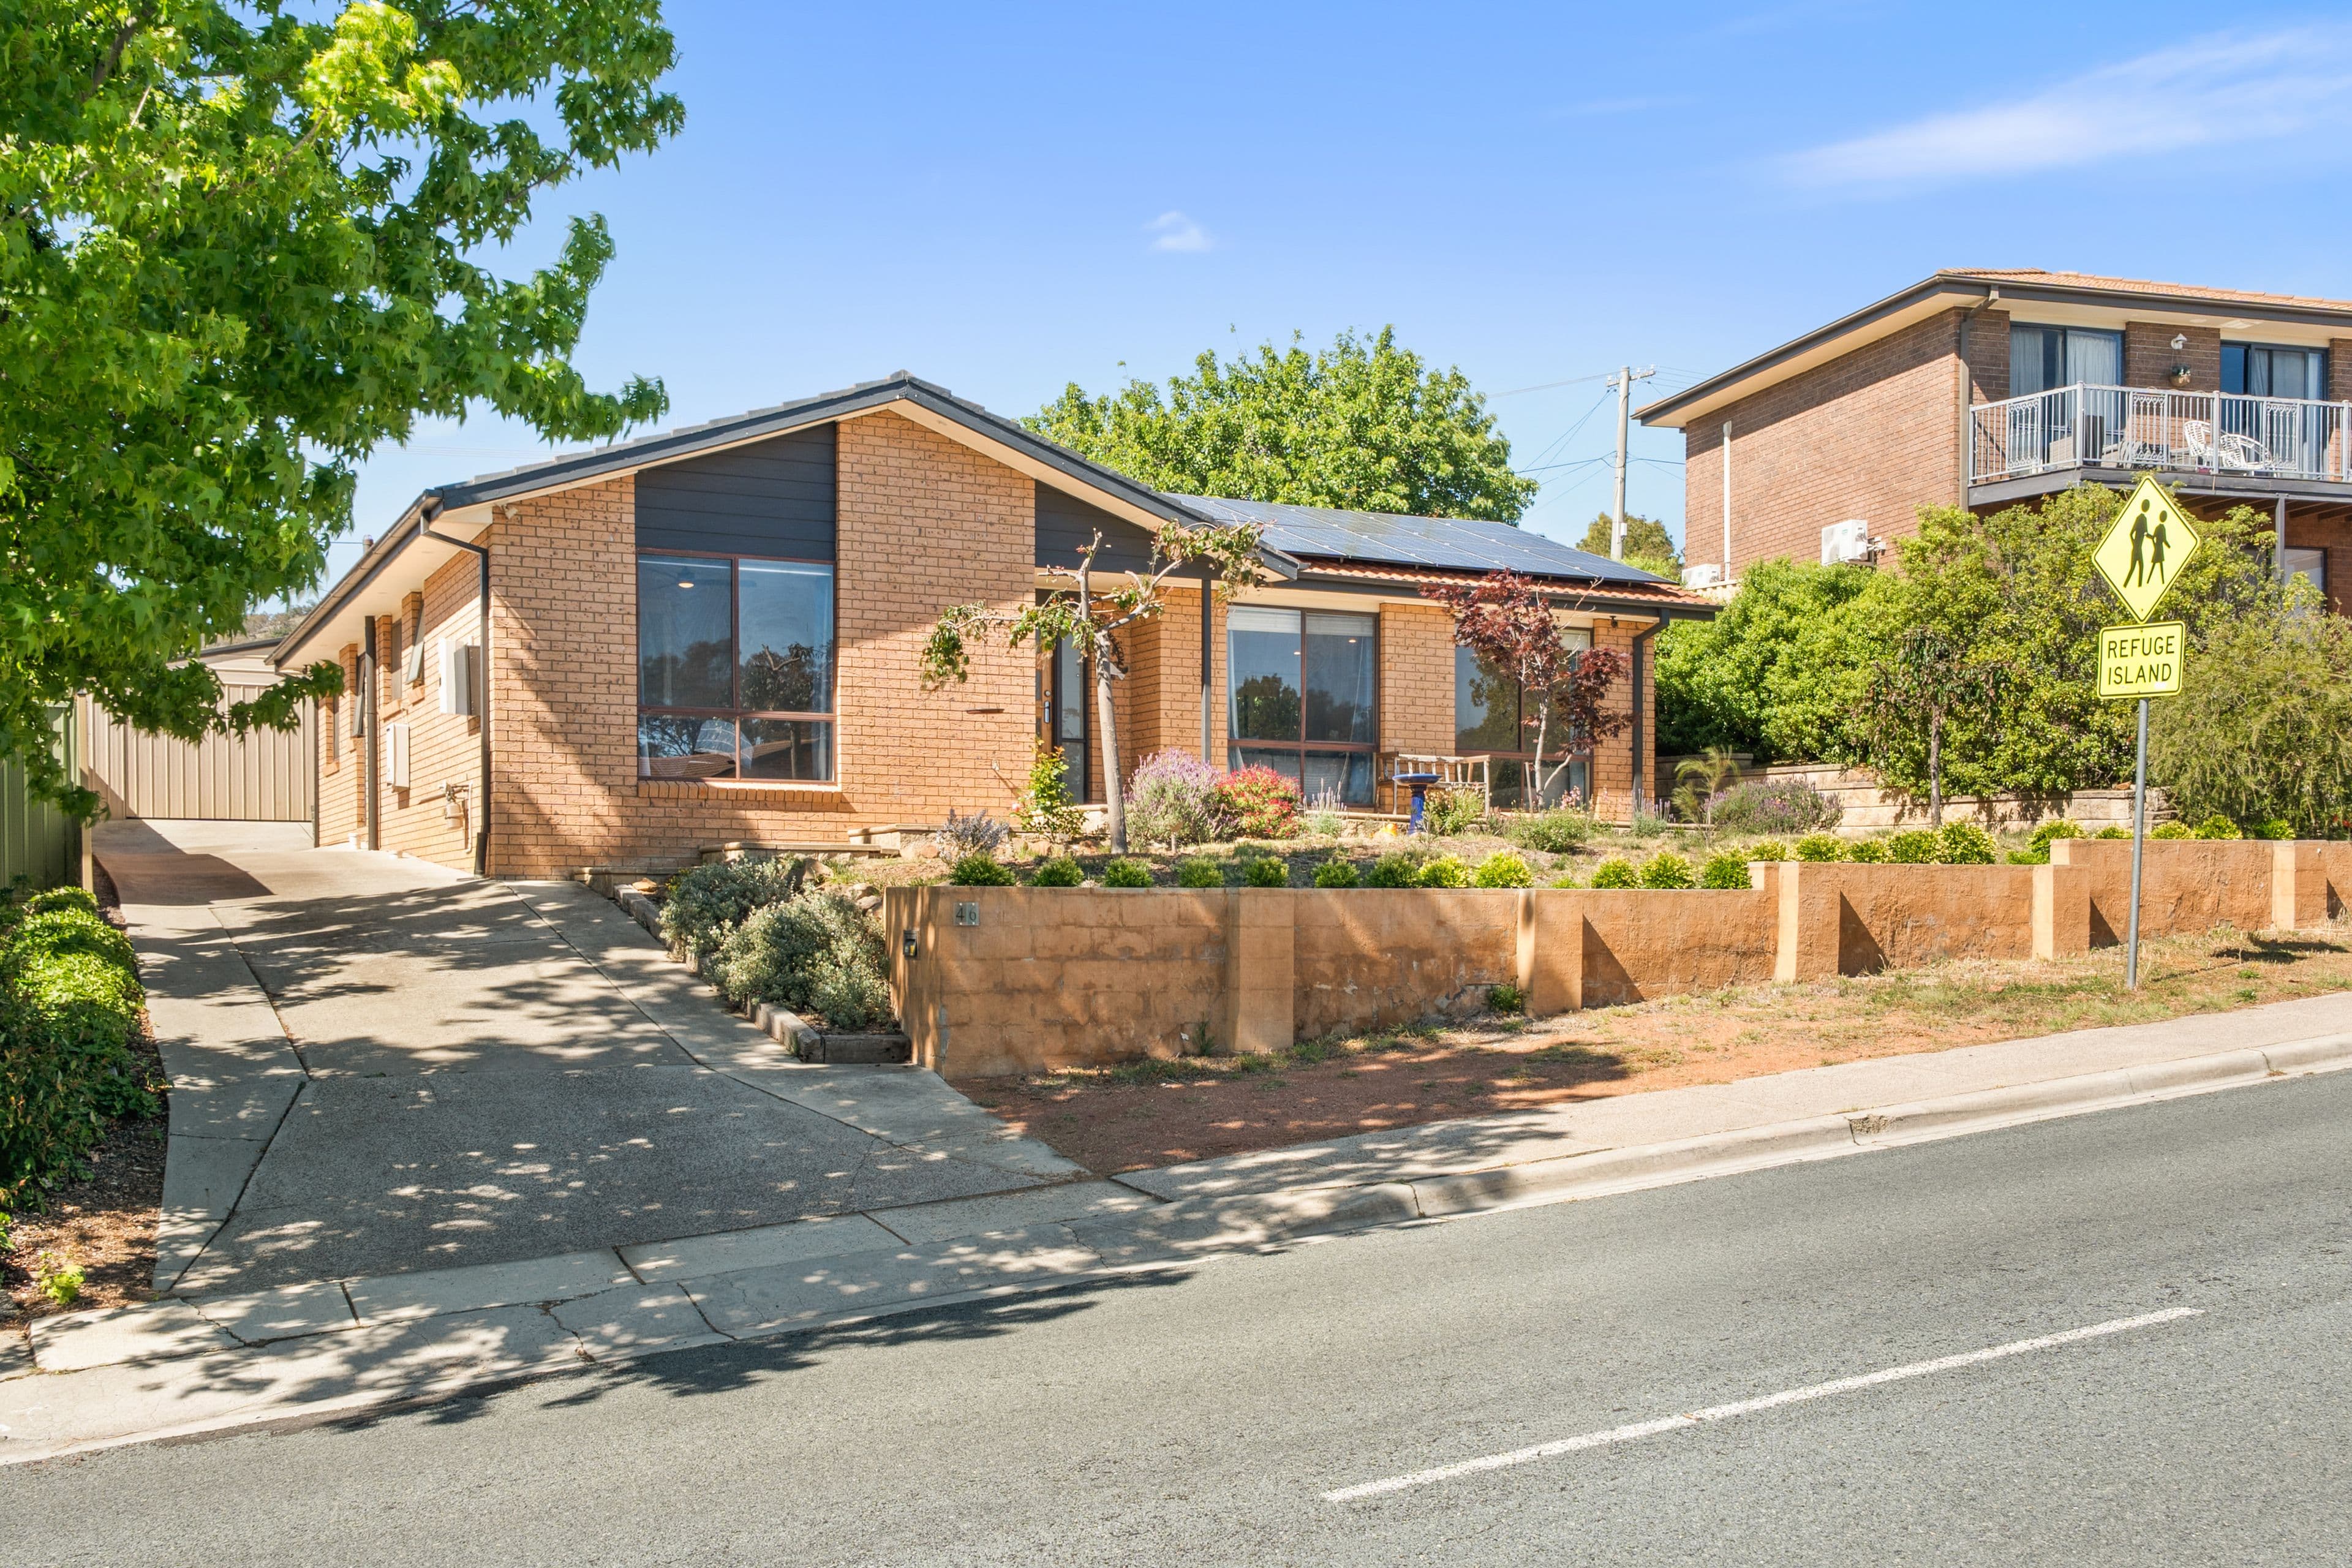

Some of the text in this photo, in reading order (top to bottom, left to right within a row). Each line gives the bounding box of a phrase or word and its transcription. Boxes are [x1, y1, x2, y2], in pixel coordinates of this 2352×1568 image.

[2108, 636, 2175, 658] REFUGE
[2108, 663, 2171, 685] ISLAND
[956, 907, 976, 921] 46
